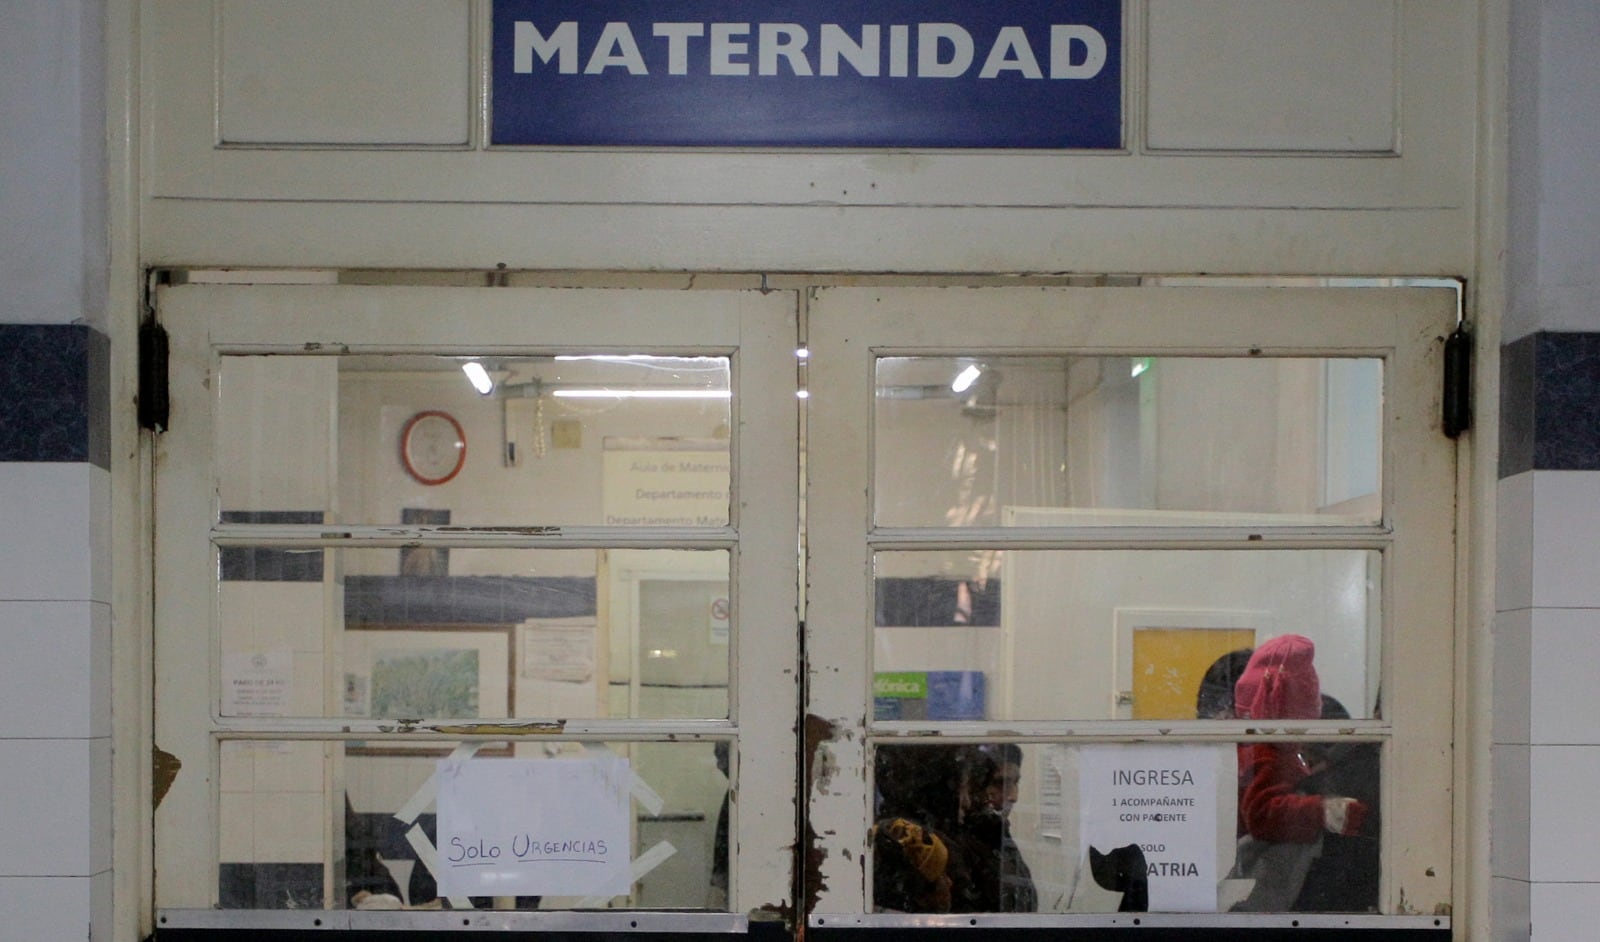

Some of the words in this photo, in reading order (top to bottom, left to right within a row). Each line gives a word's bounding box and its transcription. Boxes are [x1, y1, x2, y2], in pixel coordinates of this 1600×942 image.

[513, 20, 1108, 80] MATERNIDAD
[630, 462, 658, 472] Aula
[661, 462, 673, 472] de
[636, 488, 721, 500] Departamento
[606, 515, 692, 526] Departamento
[1113, 770, 1194, 786] INGRESA
[1112, 798, 1117, 806] 1
[1120, 796, 1195, 807] ACOMPAÑANTE
[1119, 813, 1140, 822] CON
[512, 833, 608, 858] URGENCIAS
[1140, 844, 1166, 852] SOLO
